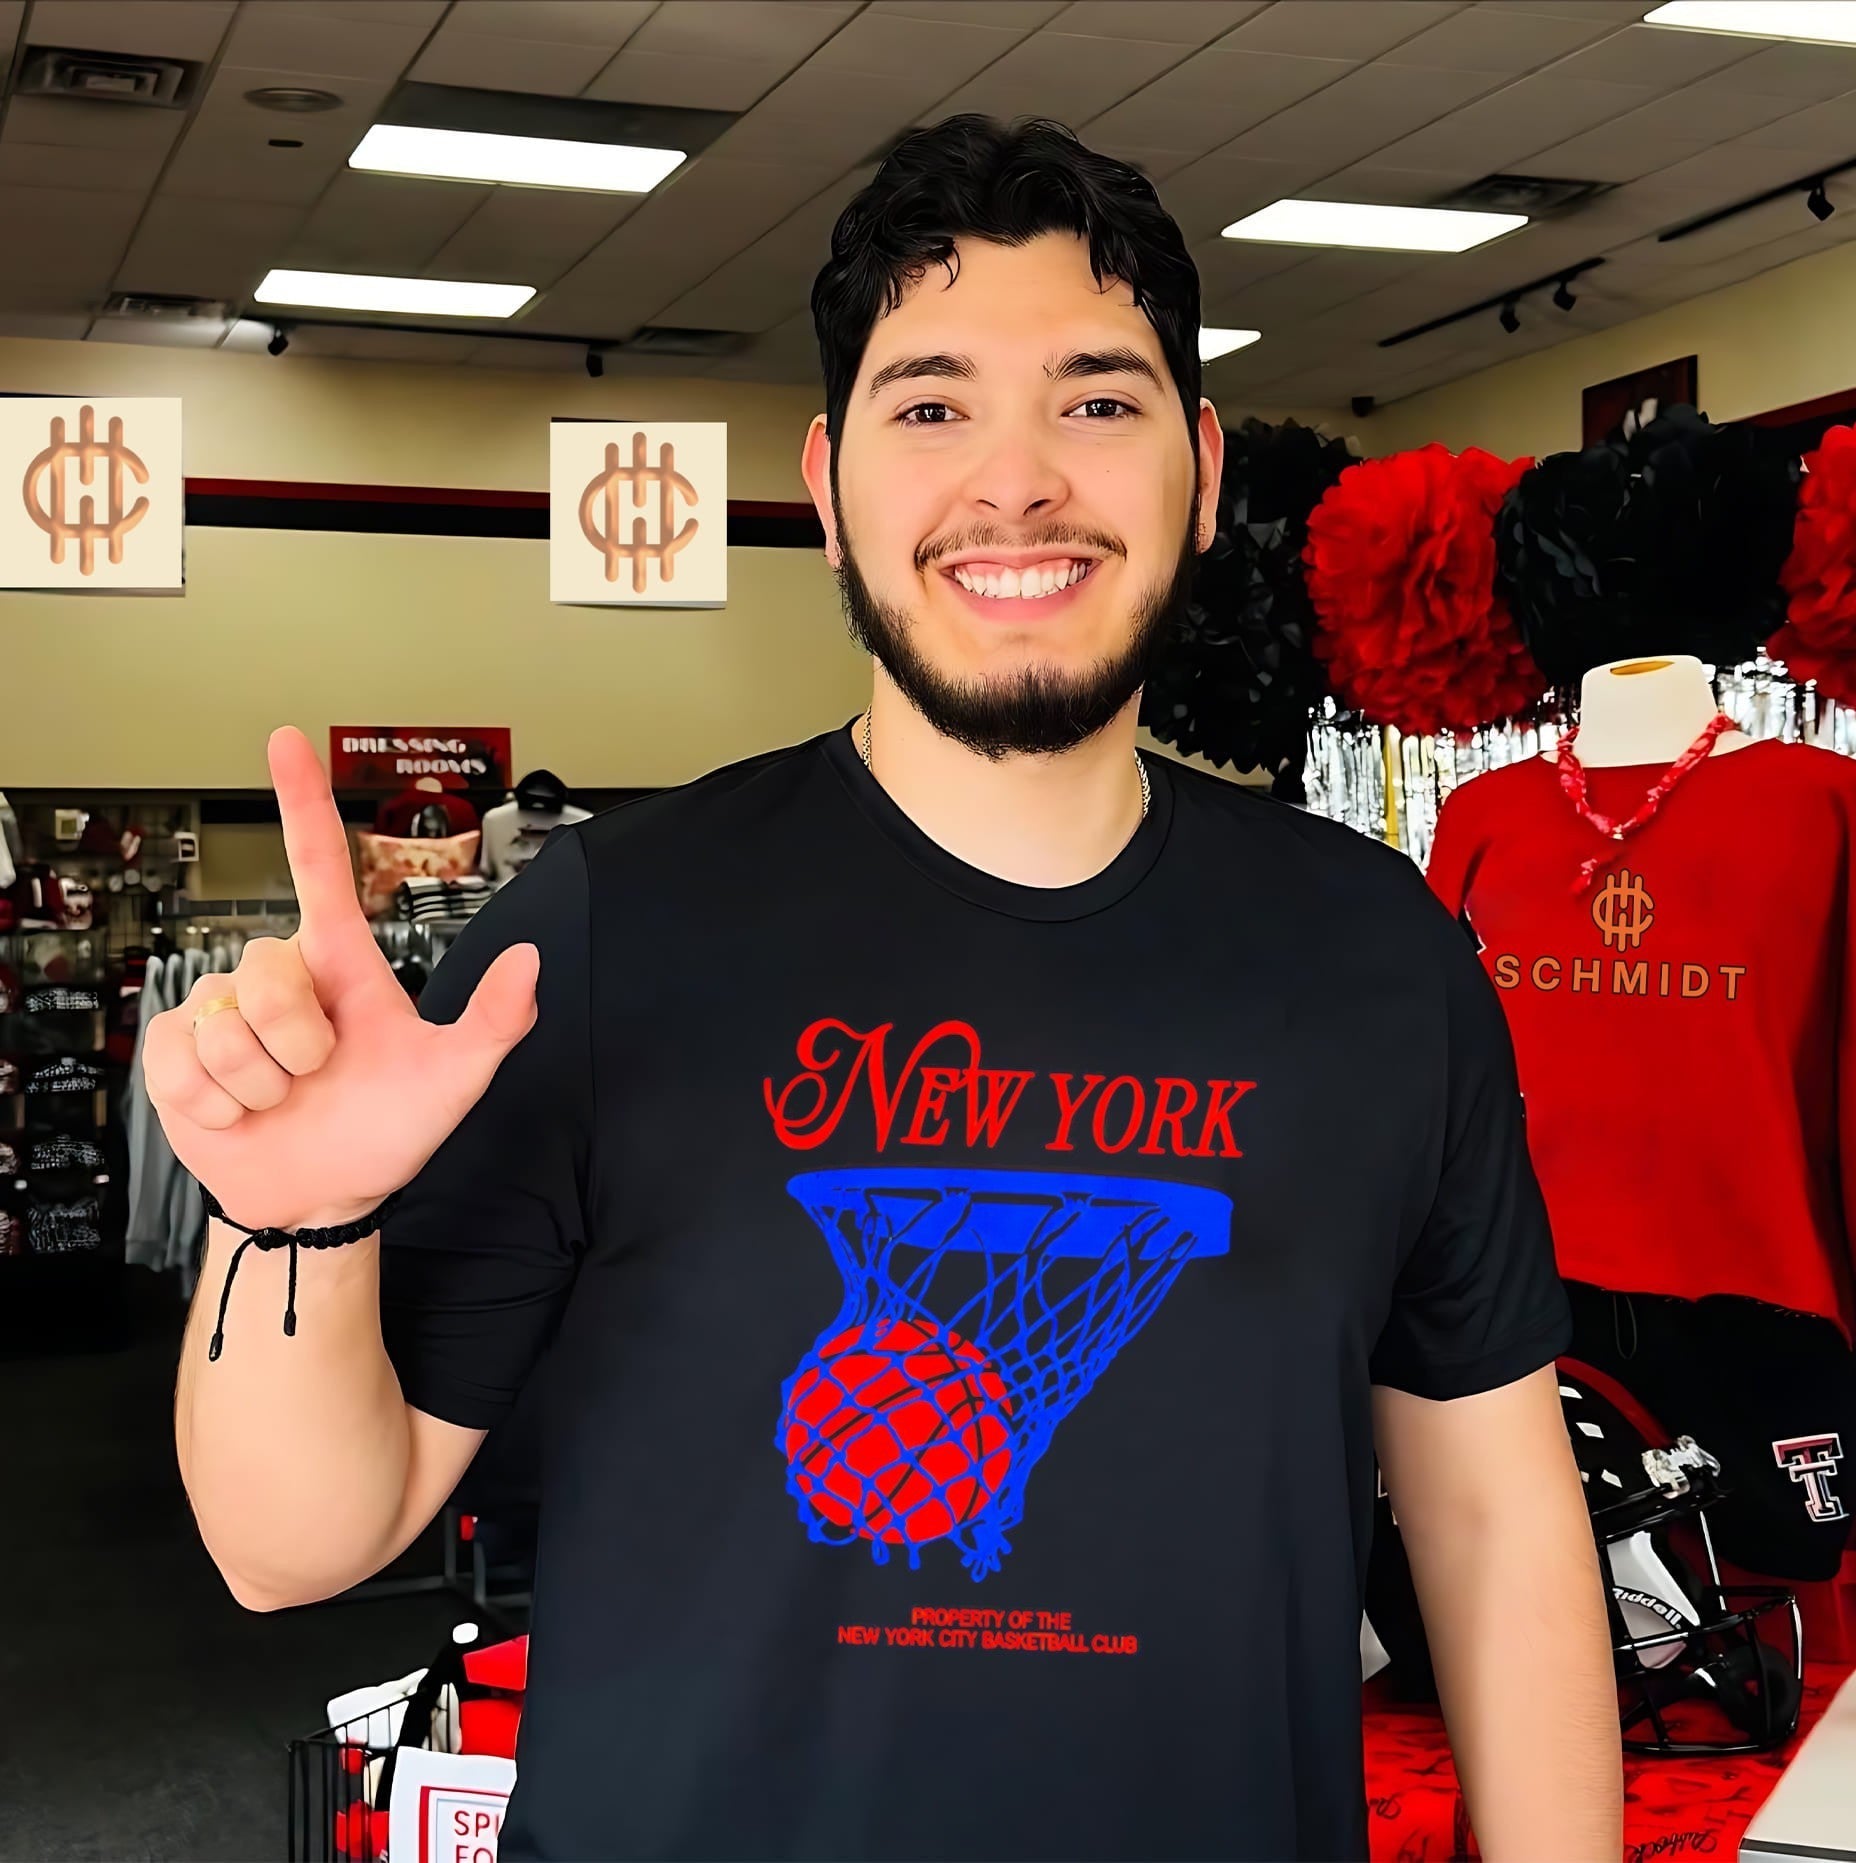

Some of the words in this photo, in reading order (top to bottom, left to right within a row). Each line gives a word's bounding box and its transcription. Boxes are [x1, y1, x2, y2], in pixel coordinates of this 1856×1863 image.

[396, 758, 487, 775] ROOMS
[1494, 954, 1747, 1000] SCHMIDT
[763, 1017, 1036, 1153] NEW
[1045, 1072, 1257, 1159] YORK
[911, 1606, 1006, 1629] PROPERTY
[1008, 1609, 1034, 1630] OF
[1036, 1611, 1072, 1631] THE
[837, 1625, 881, 1646] NEW
[884, 1626, 935, 1647] YORK
[938, 1628, 978, 1648] CITY
[981, 1629, 1090, 1653] BASKETBALL
[1091, 1633, 1138, 1655] CLUB
